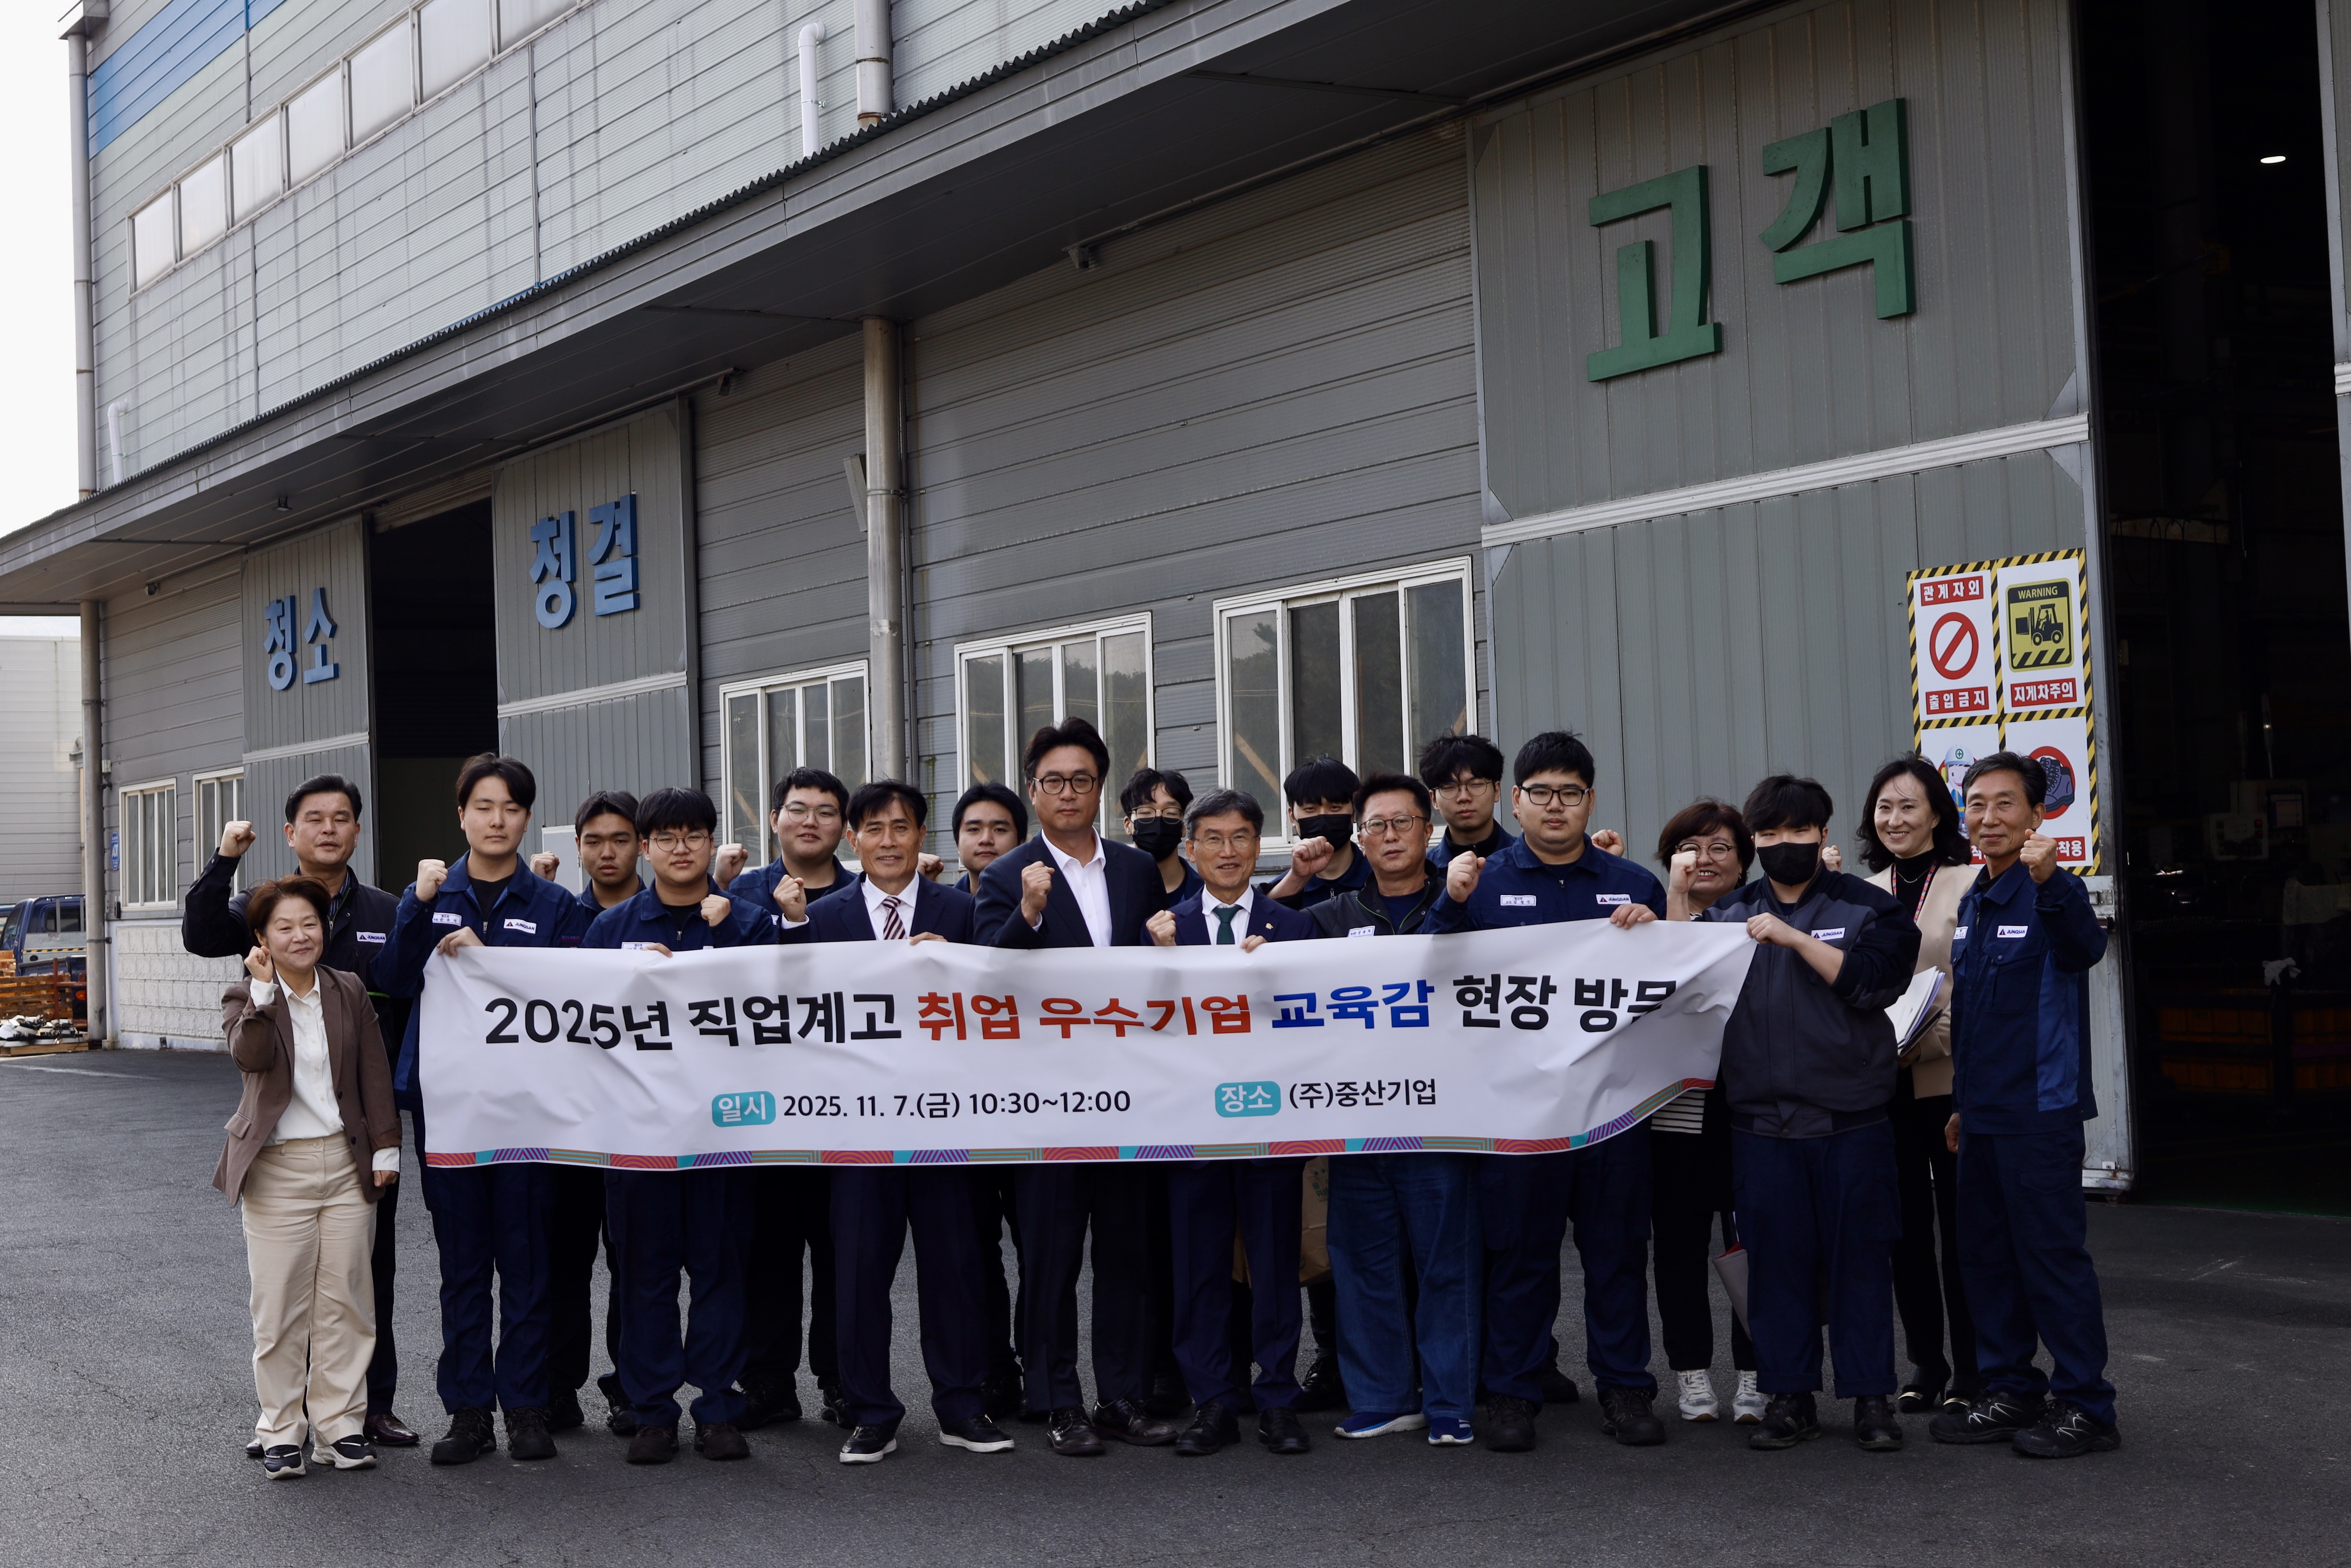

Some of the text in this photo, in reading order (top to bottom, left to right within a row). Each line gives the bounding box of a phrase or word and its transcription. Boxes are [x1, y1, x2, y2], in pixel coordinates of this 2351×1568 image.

[1587, 98, 1916, 382] 고객
[529, 494, 640, 629] 청결
[2018, 586, 2058, 599] WARNING
[263, 587, 340, 690] 청소
[2014, 682, 2074, 702] 지게차주의
[515, 922, 535, 930] JUNGSAN
[485, 998, 673, 1051] 2025년
[688, 991, 902, 1047] 직업계고
[918, 992, 1021, 1041] 취업
[1039, 990, 1251, 1039] 우수기업
[1271, 979, 1435, 1029] 교육감
[1452, 973, 1557, 1031] 현장
[718, 1090, 1131, 1122] 일시 2025. 11. 7.(금) 10:30~12:00
[1220, 1078, 1437, 1112] 장소 (주)중산기업
